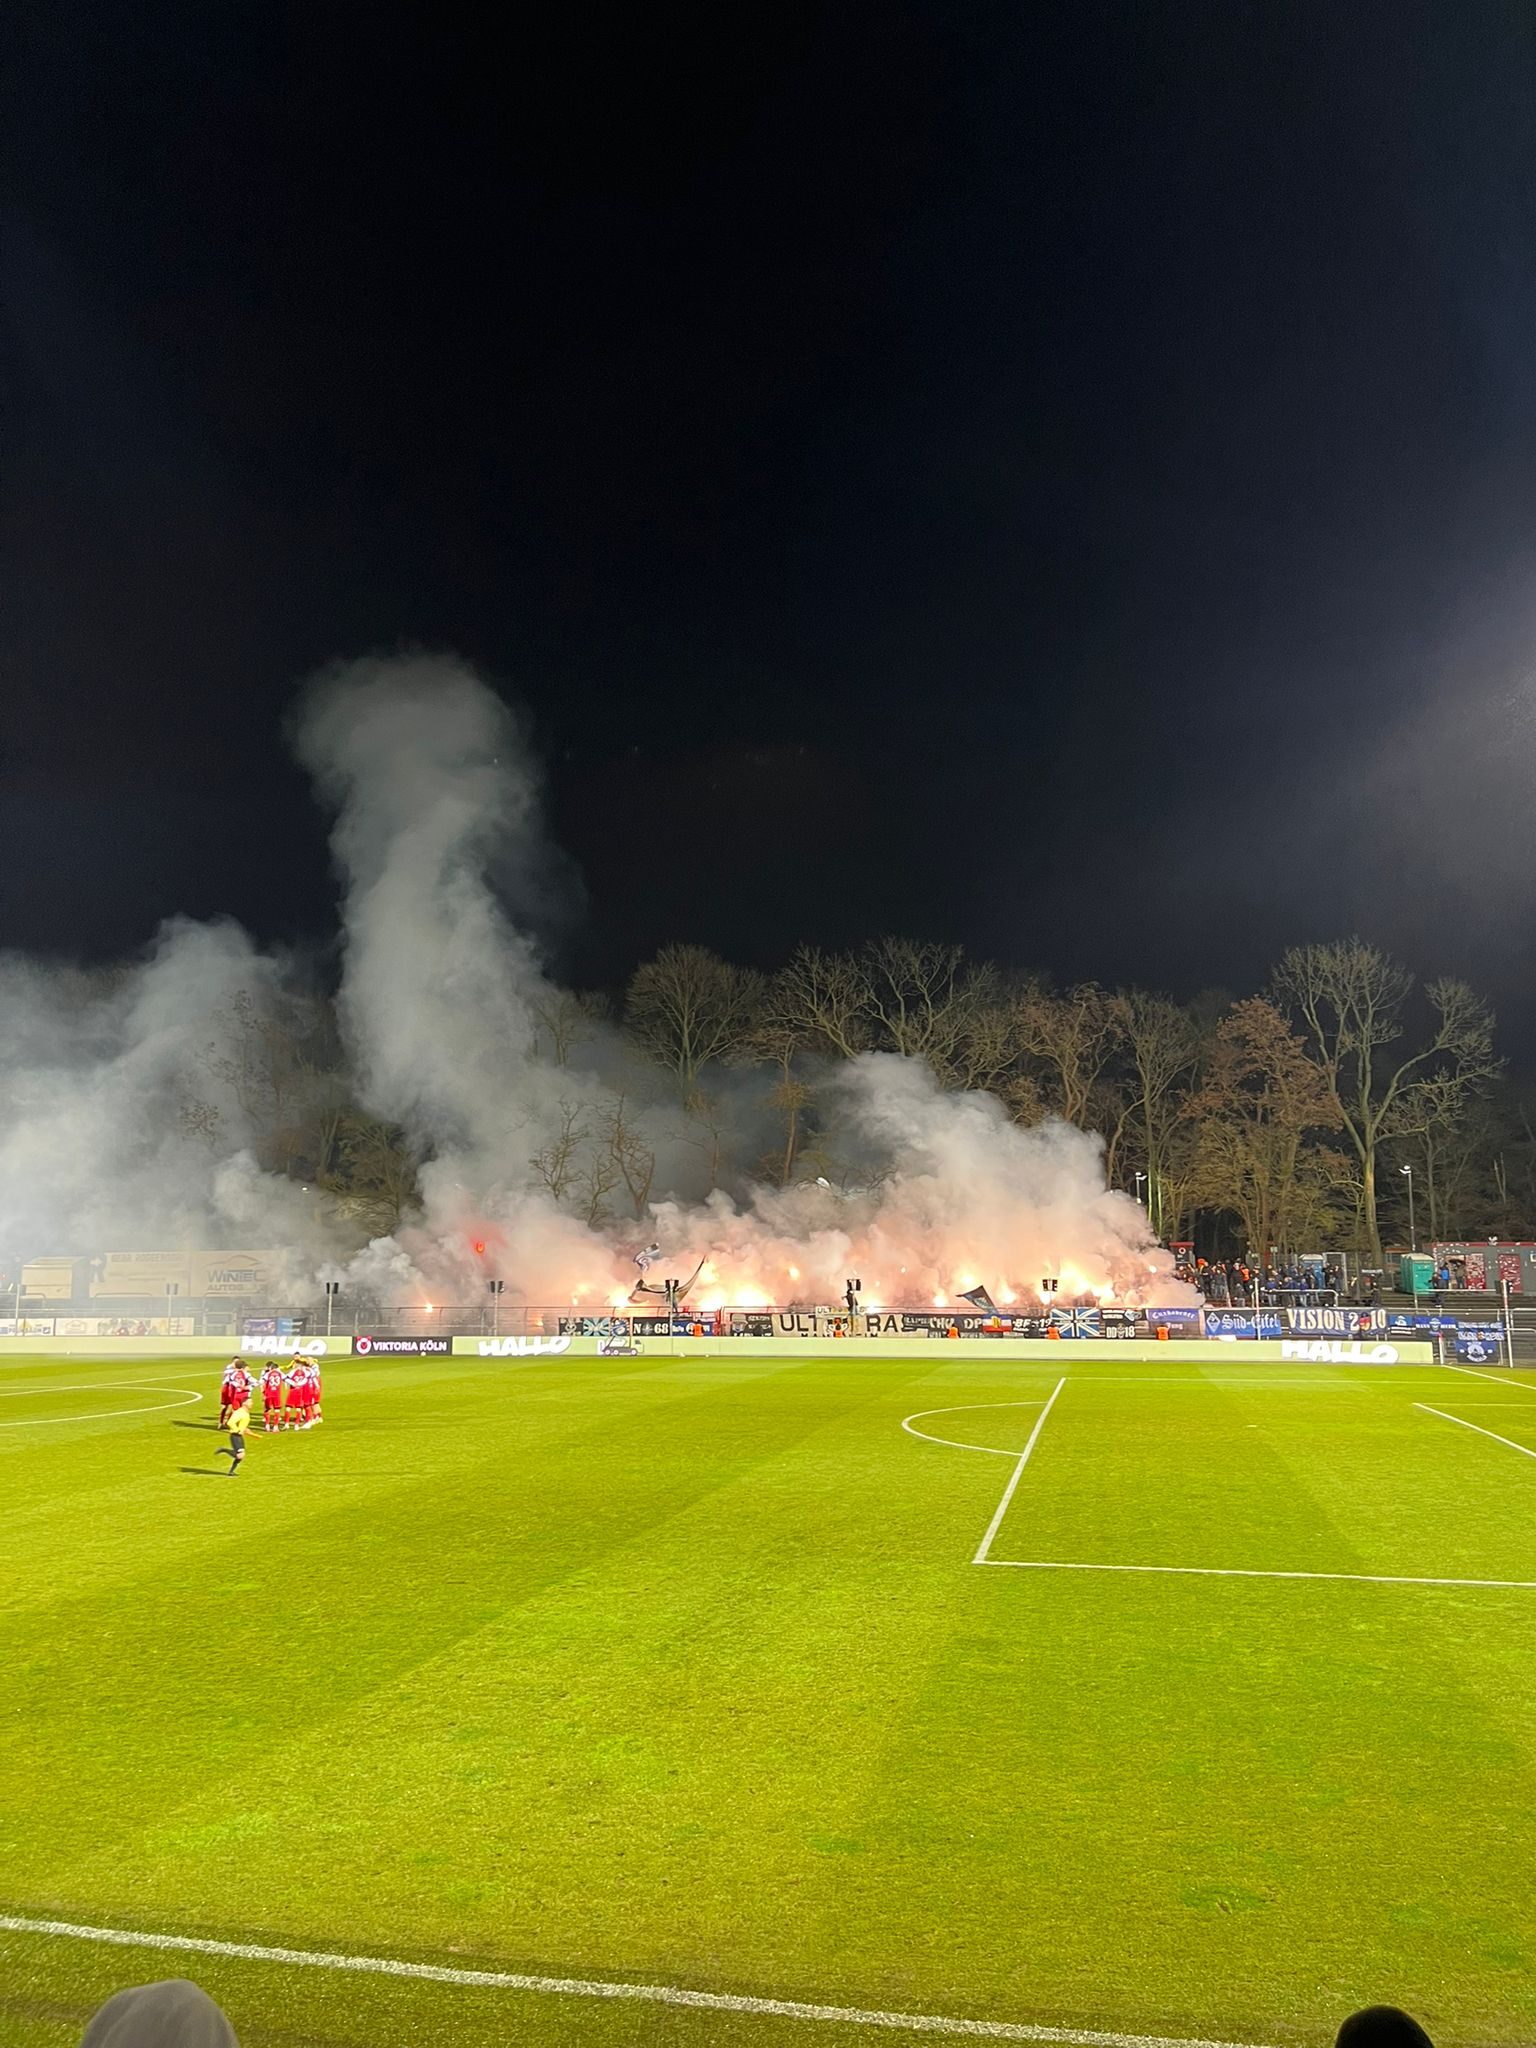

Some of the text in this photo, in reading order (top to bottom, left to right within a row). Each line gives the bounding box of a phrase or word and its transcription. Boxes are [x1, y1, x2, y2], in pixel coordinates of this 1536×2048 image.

[633, 1323, 642, 1334] N
[654, 1323, 669, 1334] 68
[1221, 1312, 1280, 1330] Süd-Eifel
[1286, 1308, 1387, 1331] VISION 210
[1125, 1326, 1135, 1338] 18
[241, 1335, 328, 1356] HALLO
[373, 1339, 447, 1352] VIKTORIA KÖLN
[478, 1335, 571, 1357] HALLO
[1281, 1339, 1399, 1364] HALLO
[269, 1376, 280, 1387] 33
